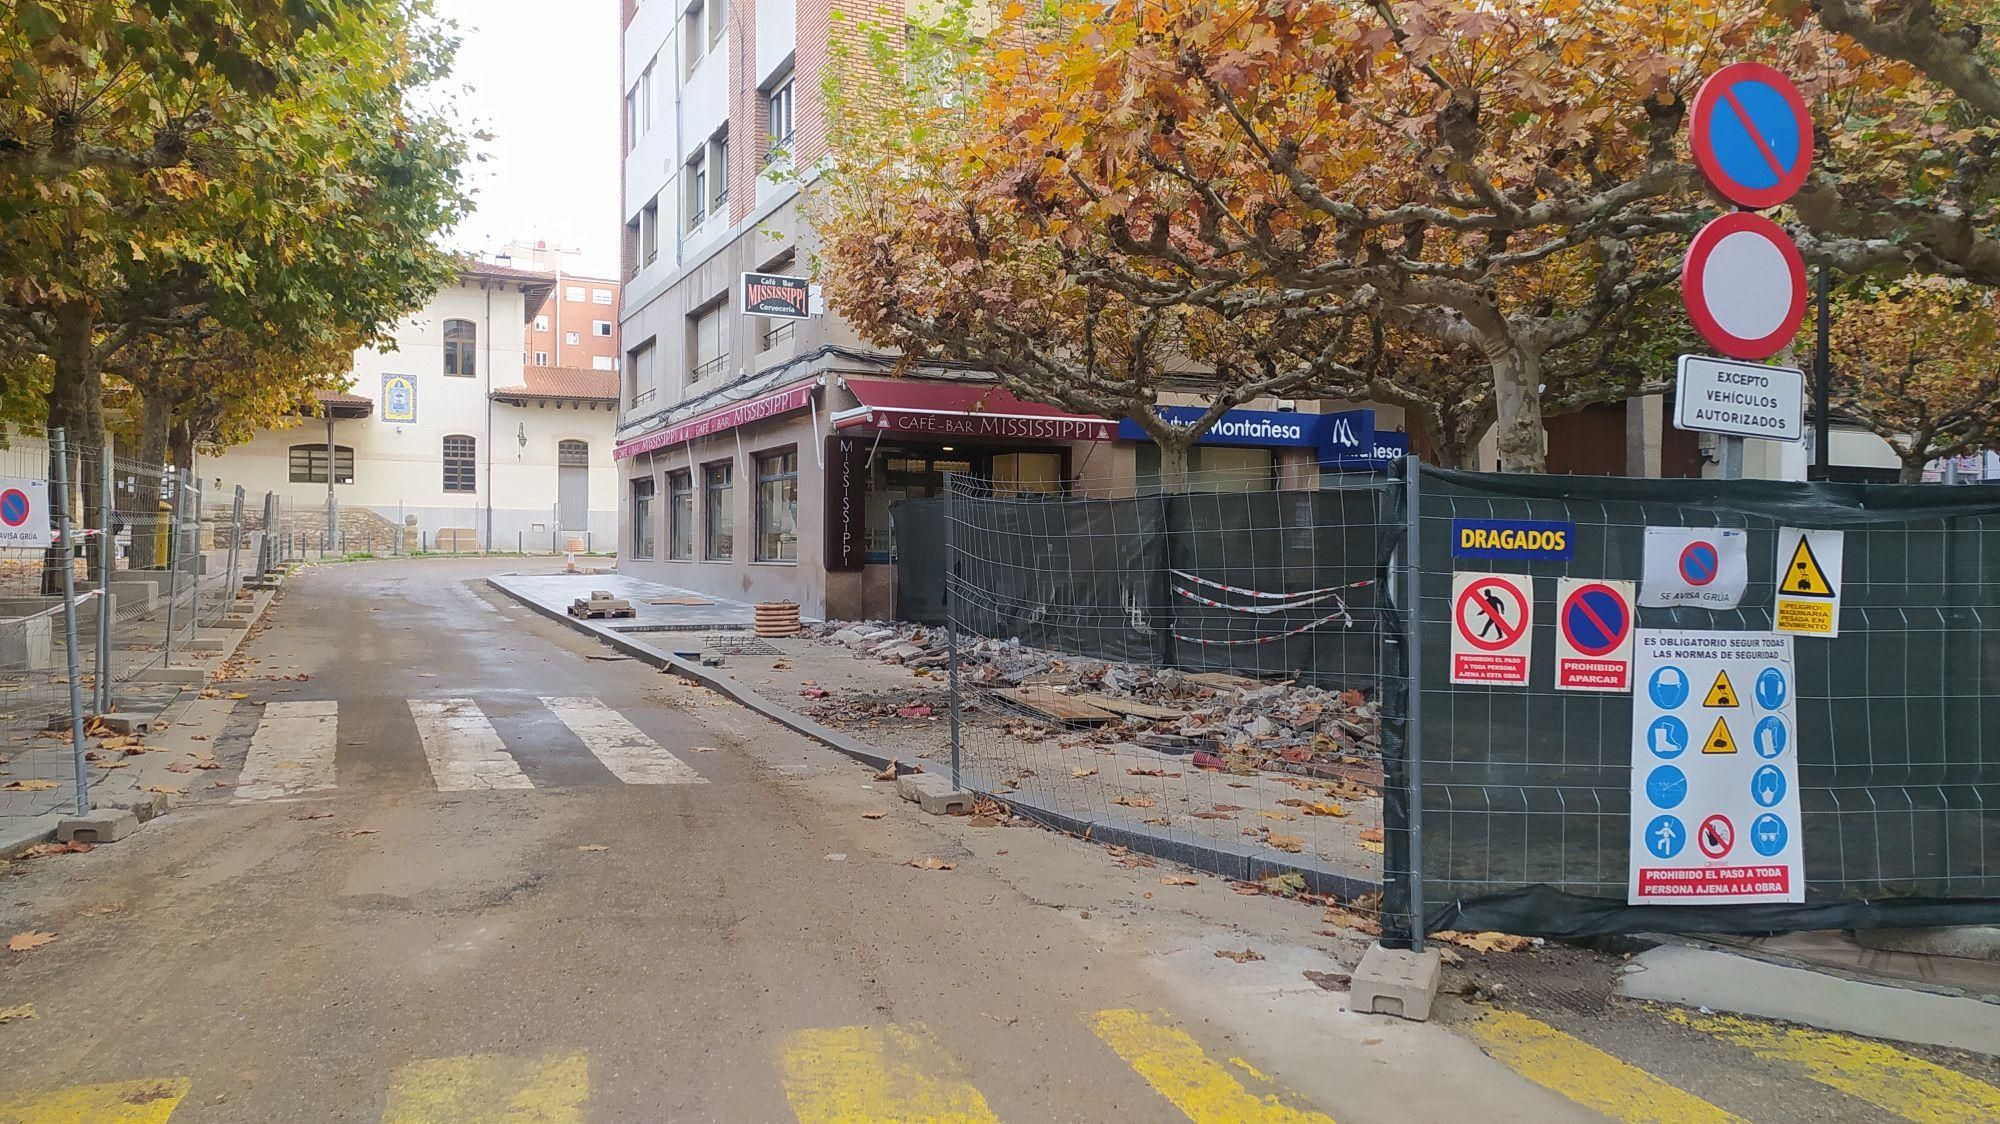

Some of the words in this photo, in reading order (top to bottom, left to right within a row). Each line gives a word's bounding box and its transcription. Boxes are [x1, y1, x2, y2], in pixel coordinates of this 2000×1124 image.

[760, 277, 776, 285] Café
[747, 284, 806, 315] MISSISSIPPI
[760, 303, 795, 313] Cervecería
[1718, 372, 1769, 388] EXCEPTO
[1707, 390, 1778, 409] VEHÍCULOS
[695, 420, 709, 435] CAFÉ
[733, 393, 792, 426] MISSISSIPPI
[1696, 409, 1786, 429] AUTORIZADOS
[980, 416, 1093, 438] MISSISSIPPI
[840, 439, 852, 567] MISSISSIPPI
[1461, 528, 1566, 551] DRAGADOS
[1660, 592, 1671, 600] SE
[1672, 591, 1700, 600] AVISA
[1644, 637, 1657, 646] ES
[1660, 638, 1727, 647] OBLIGATORIO
[1729, 639, 1760, 647] SEGUIR
[1762, 639, 1785, 647] TODAS
[1653, 650, 1672, 658] LAS
[1674, 650, 1718, 659] NORMAS
[1720, 651, 1732, 659] DE
[1735, 651, 1779, 659] SEGURIDAD
[1564, 662, 1624, 673] PROHIBIDO
[1568, 675, 1618, 684] APARCAR
[1646, 870, 1703, 880] PROHIBIDO
[1705, 870, 1718, 879] EL
[1720, 869, 1744, 879] PASO
[1746, 869, 1754, 878] A
[1756, 868, 1782, 878] TODA
[1645, 885, 1692, 894] PERSONA
[1696, 884, 1729, 894] AJENA
[1731, 884, 1738, 893] A
[1740, 884, 1753, 893] LA
[1755, 883, 1782, 892] OBRA
